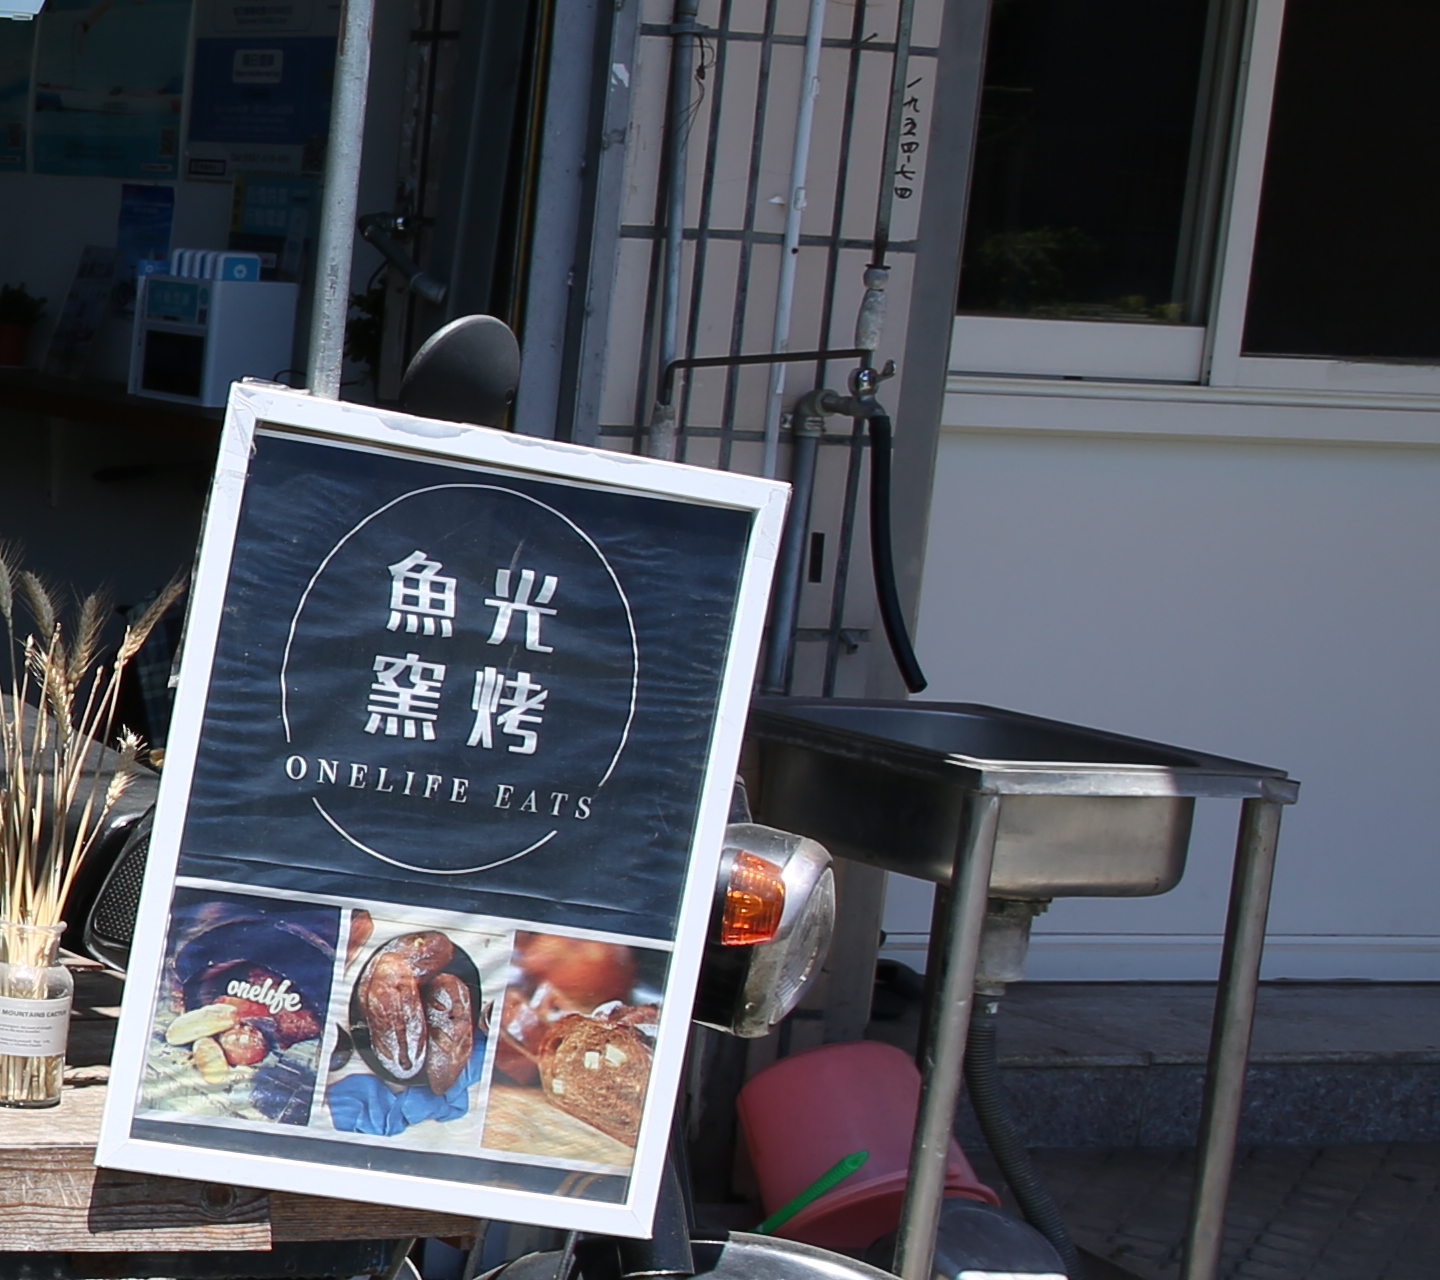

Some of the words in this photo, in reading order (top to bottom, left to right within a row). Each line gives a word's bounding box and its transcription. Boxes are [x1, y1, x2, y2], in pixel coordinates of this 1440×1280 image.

[386, 550, 558, 654] 魚光
[364, 653, 548, 755] 窯烤
[284, 754, 469, 805] ONELIFE
[493, 783, 594, 821] EATS
[226, 976, 302, 1014] onelife
